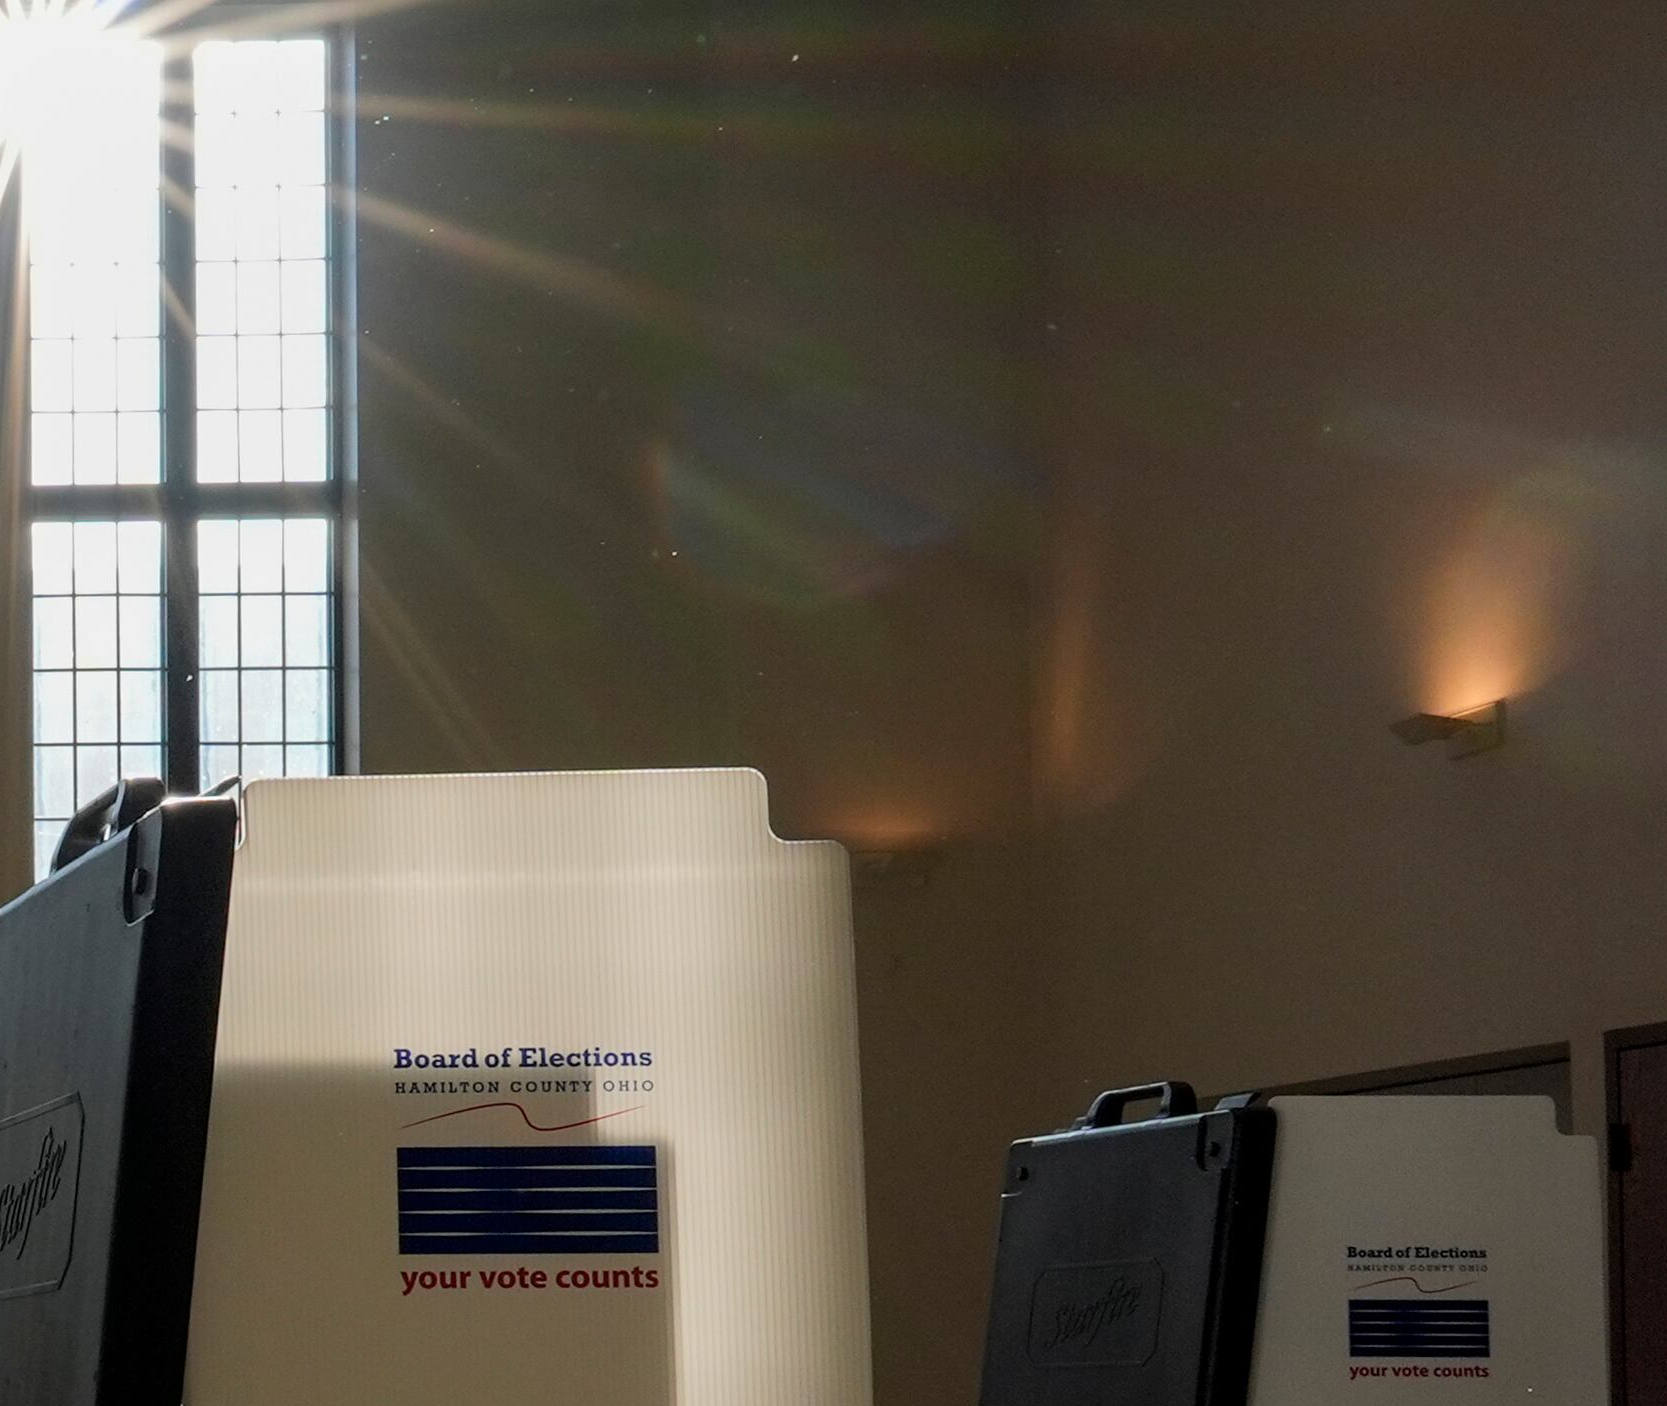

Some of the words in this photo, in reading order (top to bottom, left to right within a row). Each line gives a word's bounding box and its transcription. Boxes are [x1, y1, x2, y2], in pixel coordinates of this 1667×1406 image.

[394, 1048, 478, 1068] Board
[484, 1048, 513, 1068] of
[518, 1048, 652, 1068] Elections
[395, 1082, 500, 1094] HAMILTON
[510, 1081, 593, 1093] COUNTY
[602, 1080, 654, 1092] OHIO
[1347, 1247, 1393, 1259] Board
[1395, 1247, 1411, 1259] of
[1414, 1247, 1487, 1259] Elections
[401, 1271, 471, 1296] your
[479, 1267, 548, 1289] vote
[556, 1267, 659, 1289] counts
[1349, 1366, 1388, 1380] your
[1392, 1366, 1429, 1378] vote
[1433, 1366, 1489, 1378] counts
